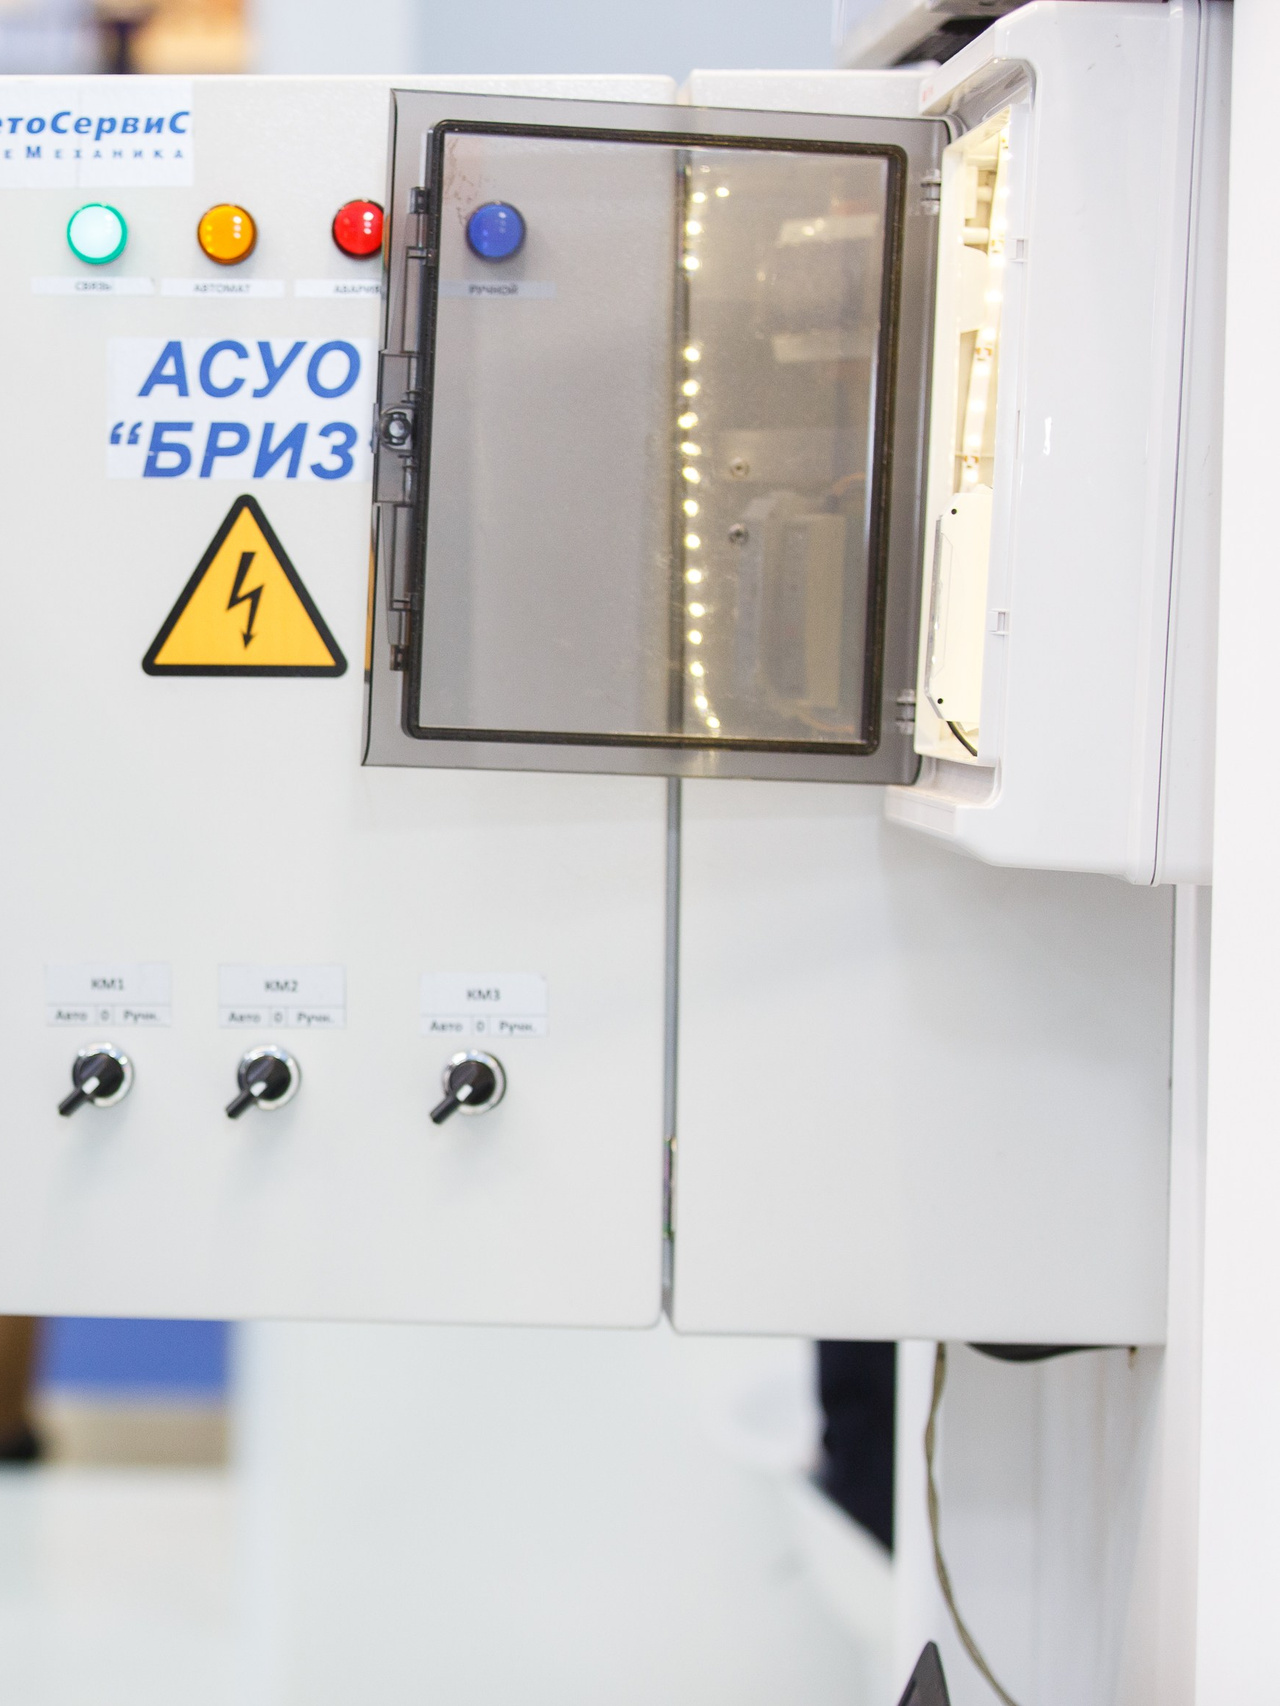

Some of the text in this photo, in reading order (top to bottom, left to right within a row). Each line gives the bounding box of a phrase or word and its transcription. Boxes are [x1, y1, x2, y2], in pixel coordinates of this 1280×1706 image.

[193, 283, 251, 293] АВТОМАТ
[469, 283, 519, 295] РУЧНОЙ
[137, 339, 361, 399] АСУО
